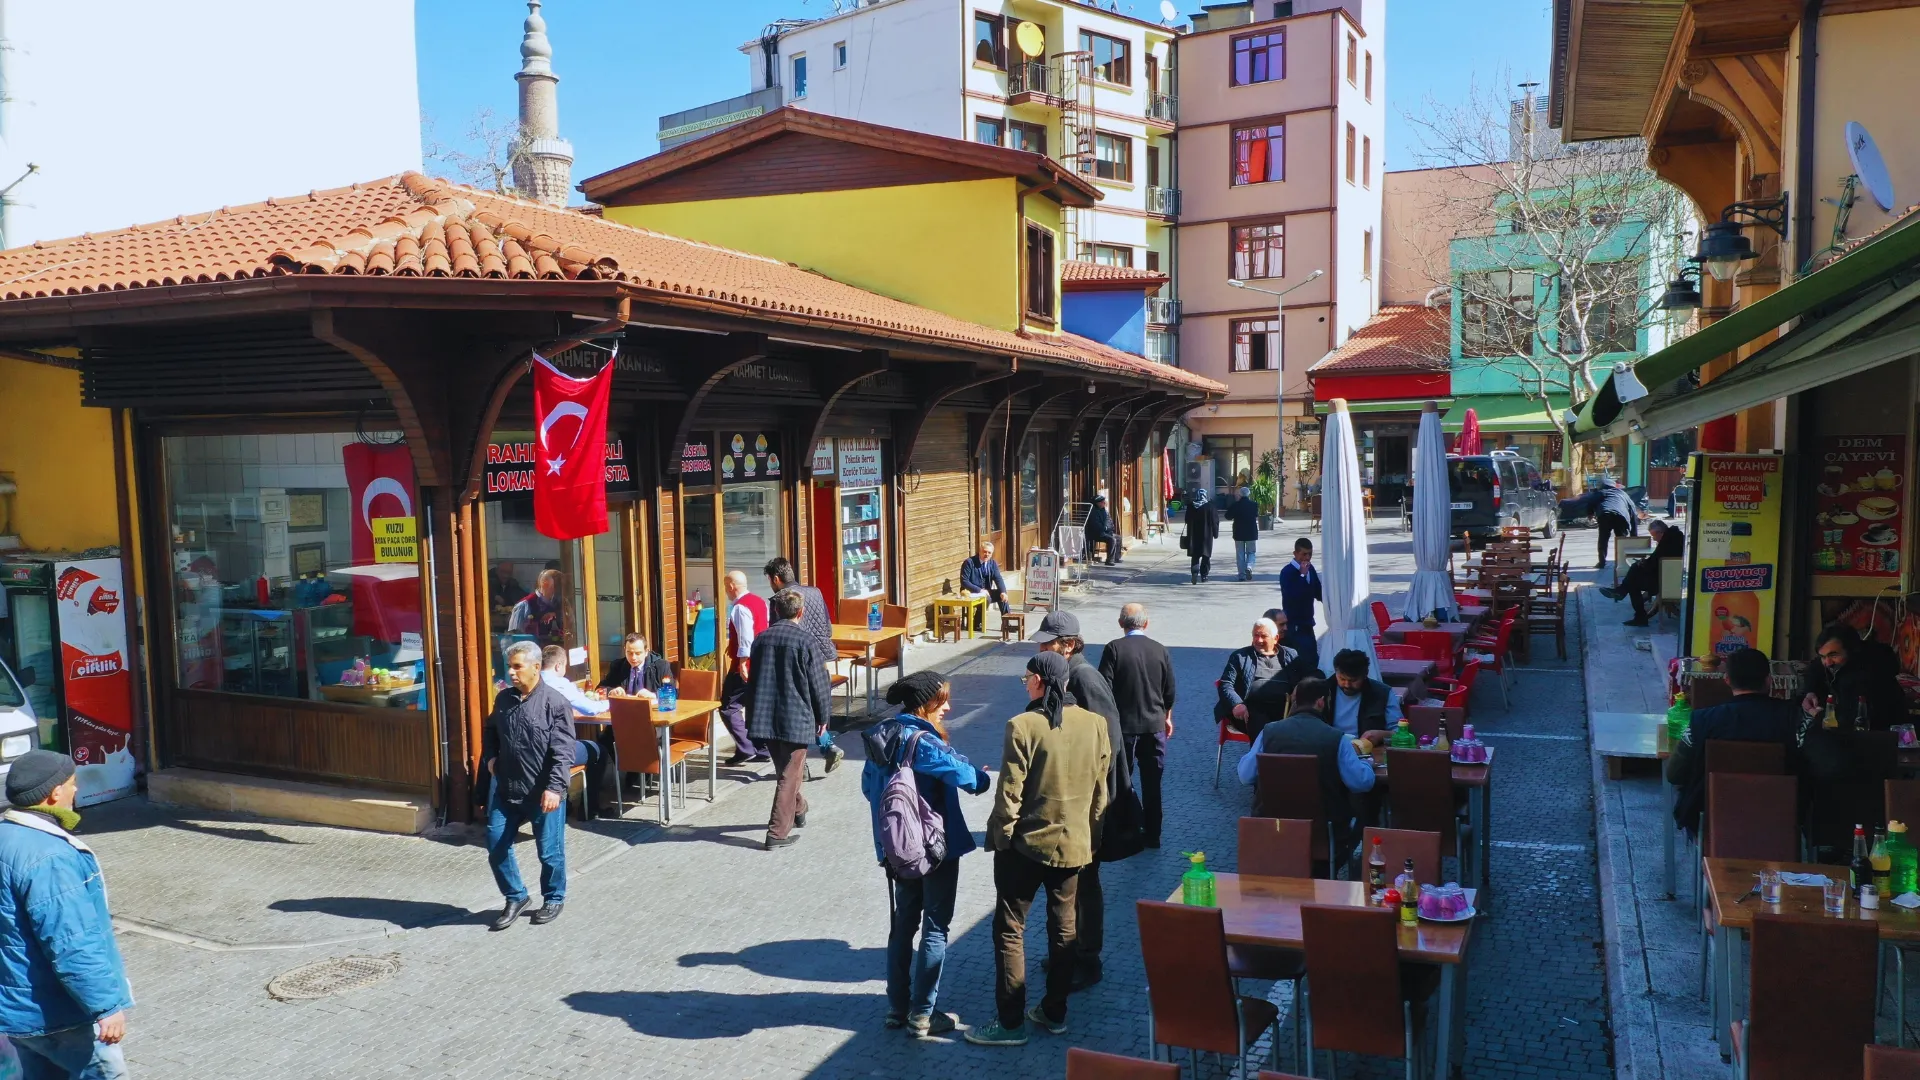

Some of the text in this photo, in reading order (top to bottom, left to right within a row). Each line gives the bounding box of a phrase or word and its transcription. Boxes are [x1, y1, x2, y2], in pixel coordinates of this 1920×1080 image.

[1838, 438, 1883, 448] DEM
[1824, 449, 1897, 464] ÇAYEVİ
[1710, 461, 1776, 473] ÇAY KAHVE
[1717, 484, 1729, 492] ÇAY
[385, 523, 404, 534] KUZU
[387, 536, 400, 544] PAÇA
[381, 547, 414, 558] BULUNUR
[1705, 568, 1768, 579] koruyucu
[1707, 577, 1764, 591] içermez!
[77, 659, 118, 676] çiftlik
